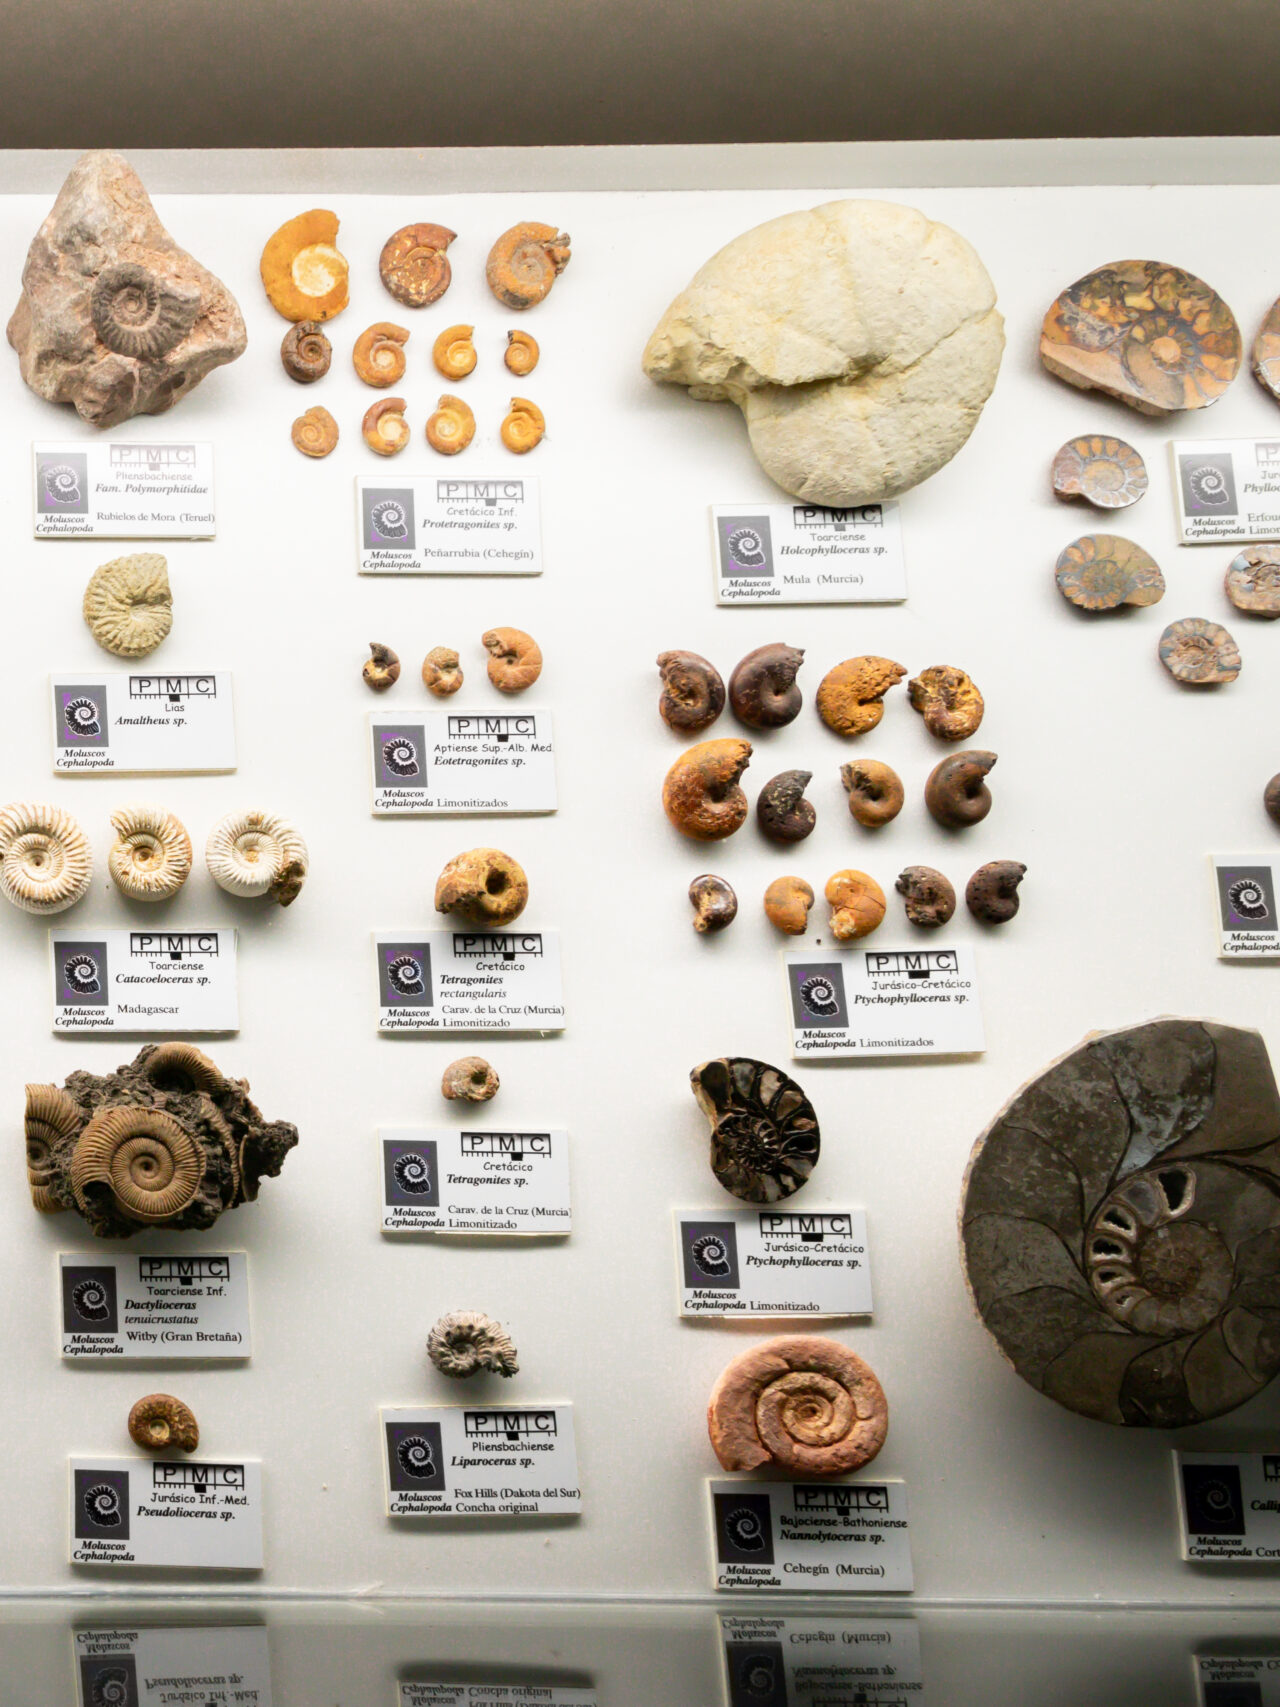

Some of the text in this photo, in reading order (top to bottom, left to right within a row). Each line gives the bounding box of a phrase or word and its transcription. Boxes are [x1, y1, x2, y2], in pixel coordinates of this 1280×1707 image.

[96, 484, 121, 493] Fam.
[503, 521, 517, 530] sp.
[873, 547, 888, 555] sp.
[783, 574, 863, 584] Mula (Murcia)
[165, 704, 185, 712] Lias
[115, 716, 187, 727] Amaltheus sp.
[434, 744, 478, 753] Aptiense
[434, 757, 526, 767] Eotetragonites sp.
[437, 799, 508, 807] Limonitizados
[149, 962, 204, 970] Toarciense
[116, 974, 211, 985] Catacoeloceras sp.
[440, 975, 503, 986] Tetragonites
[440, 990, 507, 1000] rectangularis
[854, 994, 969, 1005] Ptychophylloceras sp.
[117, 1005, 179, 1015] Madagascar
[475, 1006, 487, 1014] de
[490, 1006, 496, 1014] la
[499, 1006, 521, 1014] Cruz
[524, 1006, 565, 1015] (Murcia)
[443, 1019, 510, 1027] Limonitizado
[860, 1038, 934, 1048] Limonitizados
[446, 1174, 529, 1187] Tetragonites sp.
[746, 1256, 862, 1268] Ptychophylloceras sp.
[147, 1287, 226, 1296] Toarciense Inf.
[692, 1291, 736, 1299] Moluscos
[125, 1300, 197, 1311] Dactylioceras
[685, 1300, 746, 1310] Cephalopoda
[750, 1301, 820, 1311] Limonitizado
[127, 1332, 242, 1343] Witby (Gran Bretaña)
[473, 1442, 554, 1451] Pliensbachiense
[452, 1456, 535, 1467] Liparoceras sp.
[151, 1493, 196, 1503] Jurásico
[454, 1488, 580, 1499] Fox Hills (Dakota del Sur)
[137, 1506, 235, 1520] Pseudolioceras sp.
[456, 1503, 539, 1514] Concha original
[870, 1533, 885, 1544] sp.
[82, 1541, 126, 1550] Moluscos
[74, 1551, 135, 1562] Cephalopoda
[836, 1565, 885, 1577] (Murcia)
